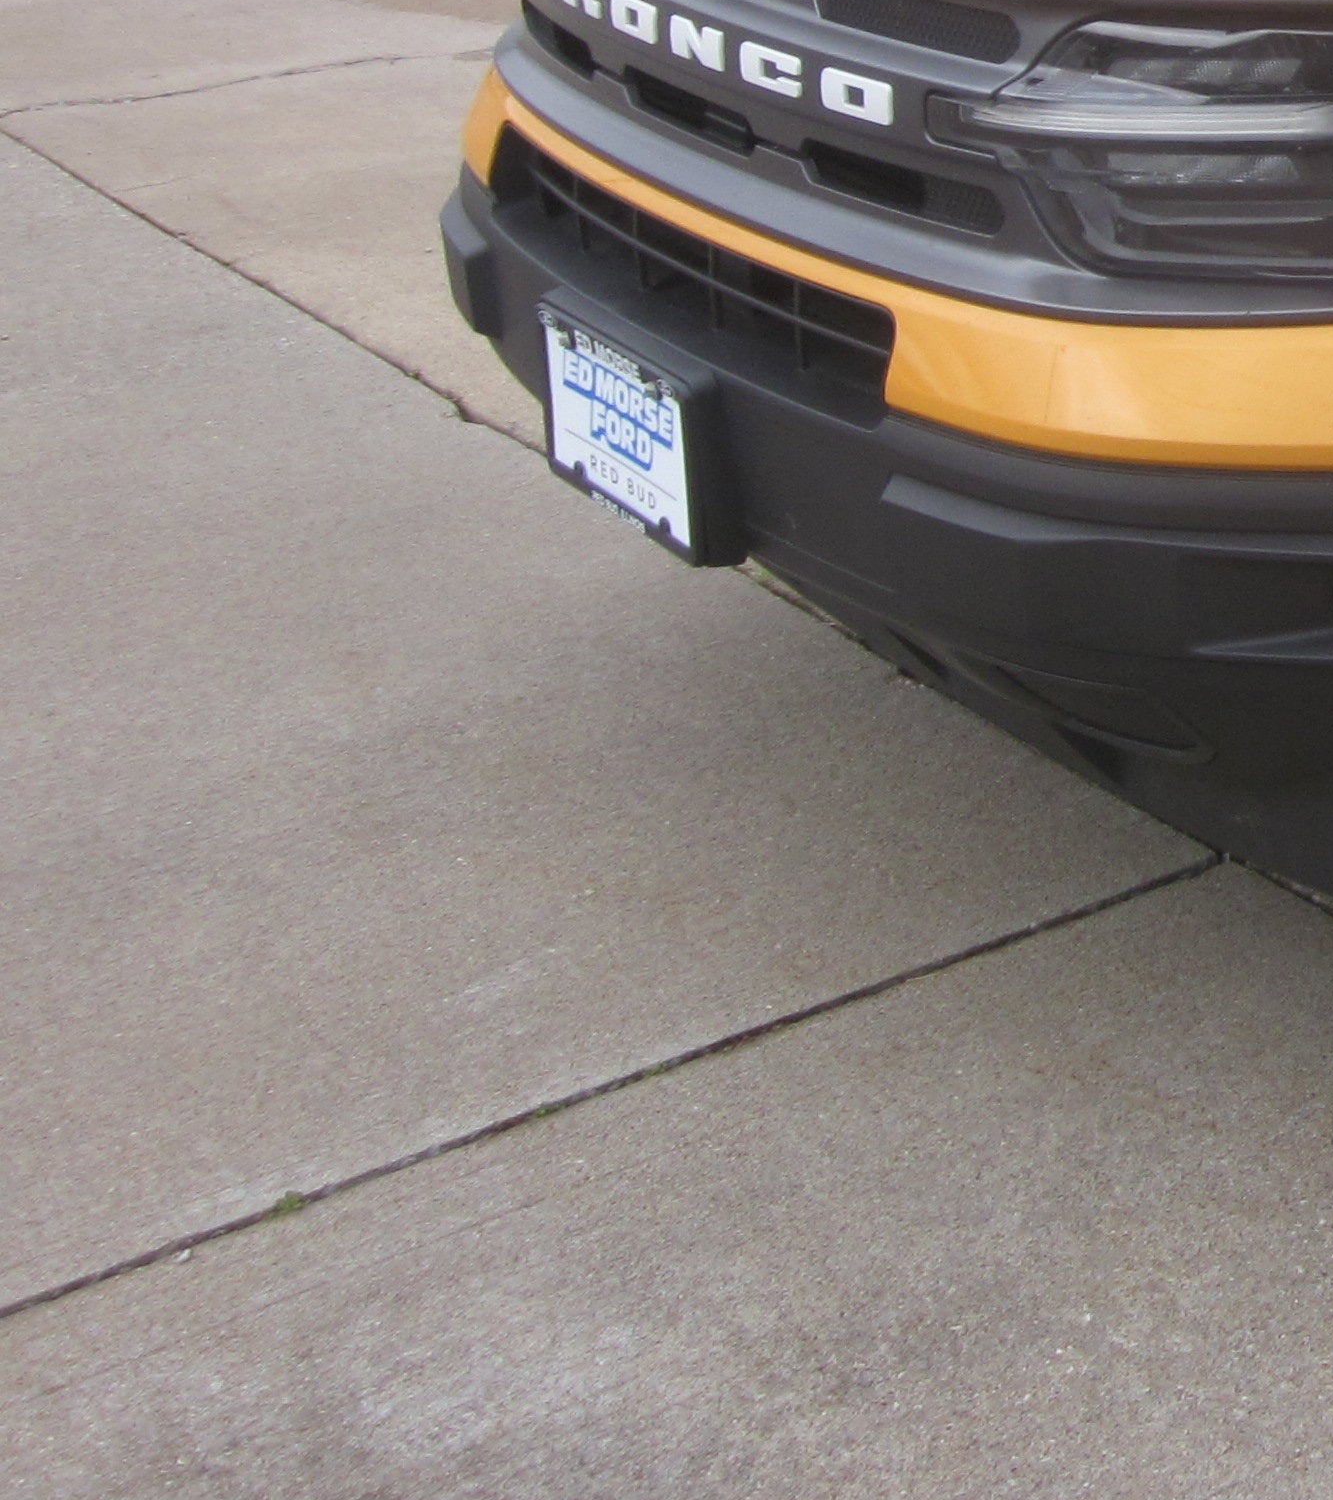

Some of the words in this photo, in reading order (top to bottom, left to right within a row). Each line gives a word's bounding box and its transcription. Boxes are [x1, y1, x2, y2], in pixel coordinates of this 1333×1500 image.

[563, 350, 594, 396] ED
[594, 364, 675, 447] MORSE
[590, 400, 653, 470] FORD
[589, 454, 619, 485] RED
[626, 477, 657, 510] BUD
